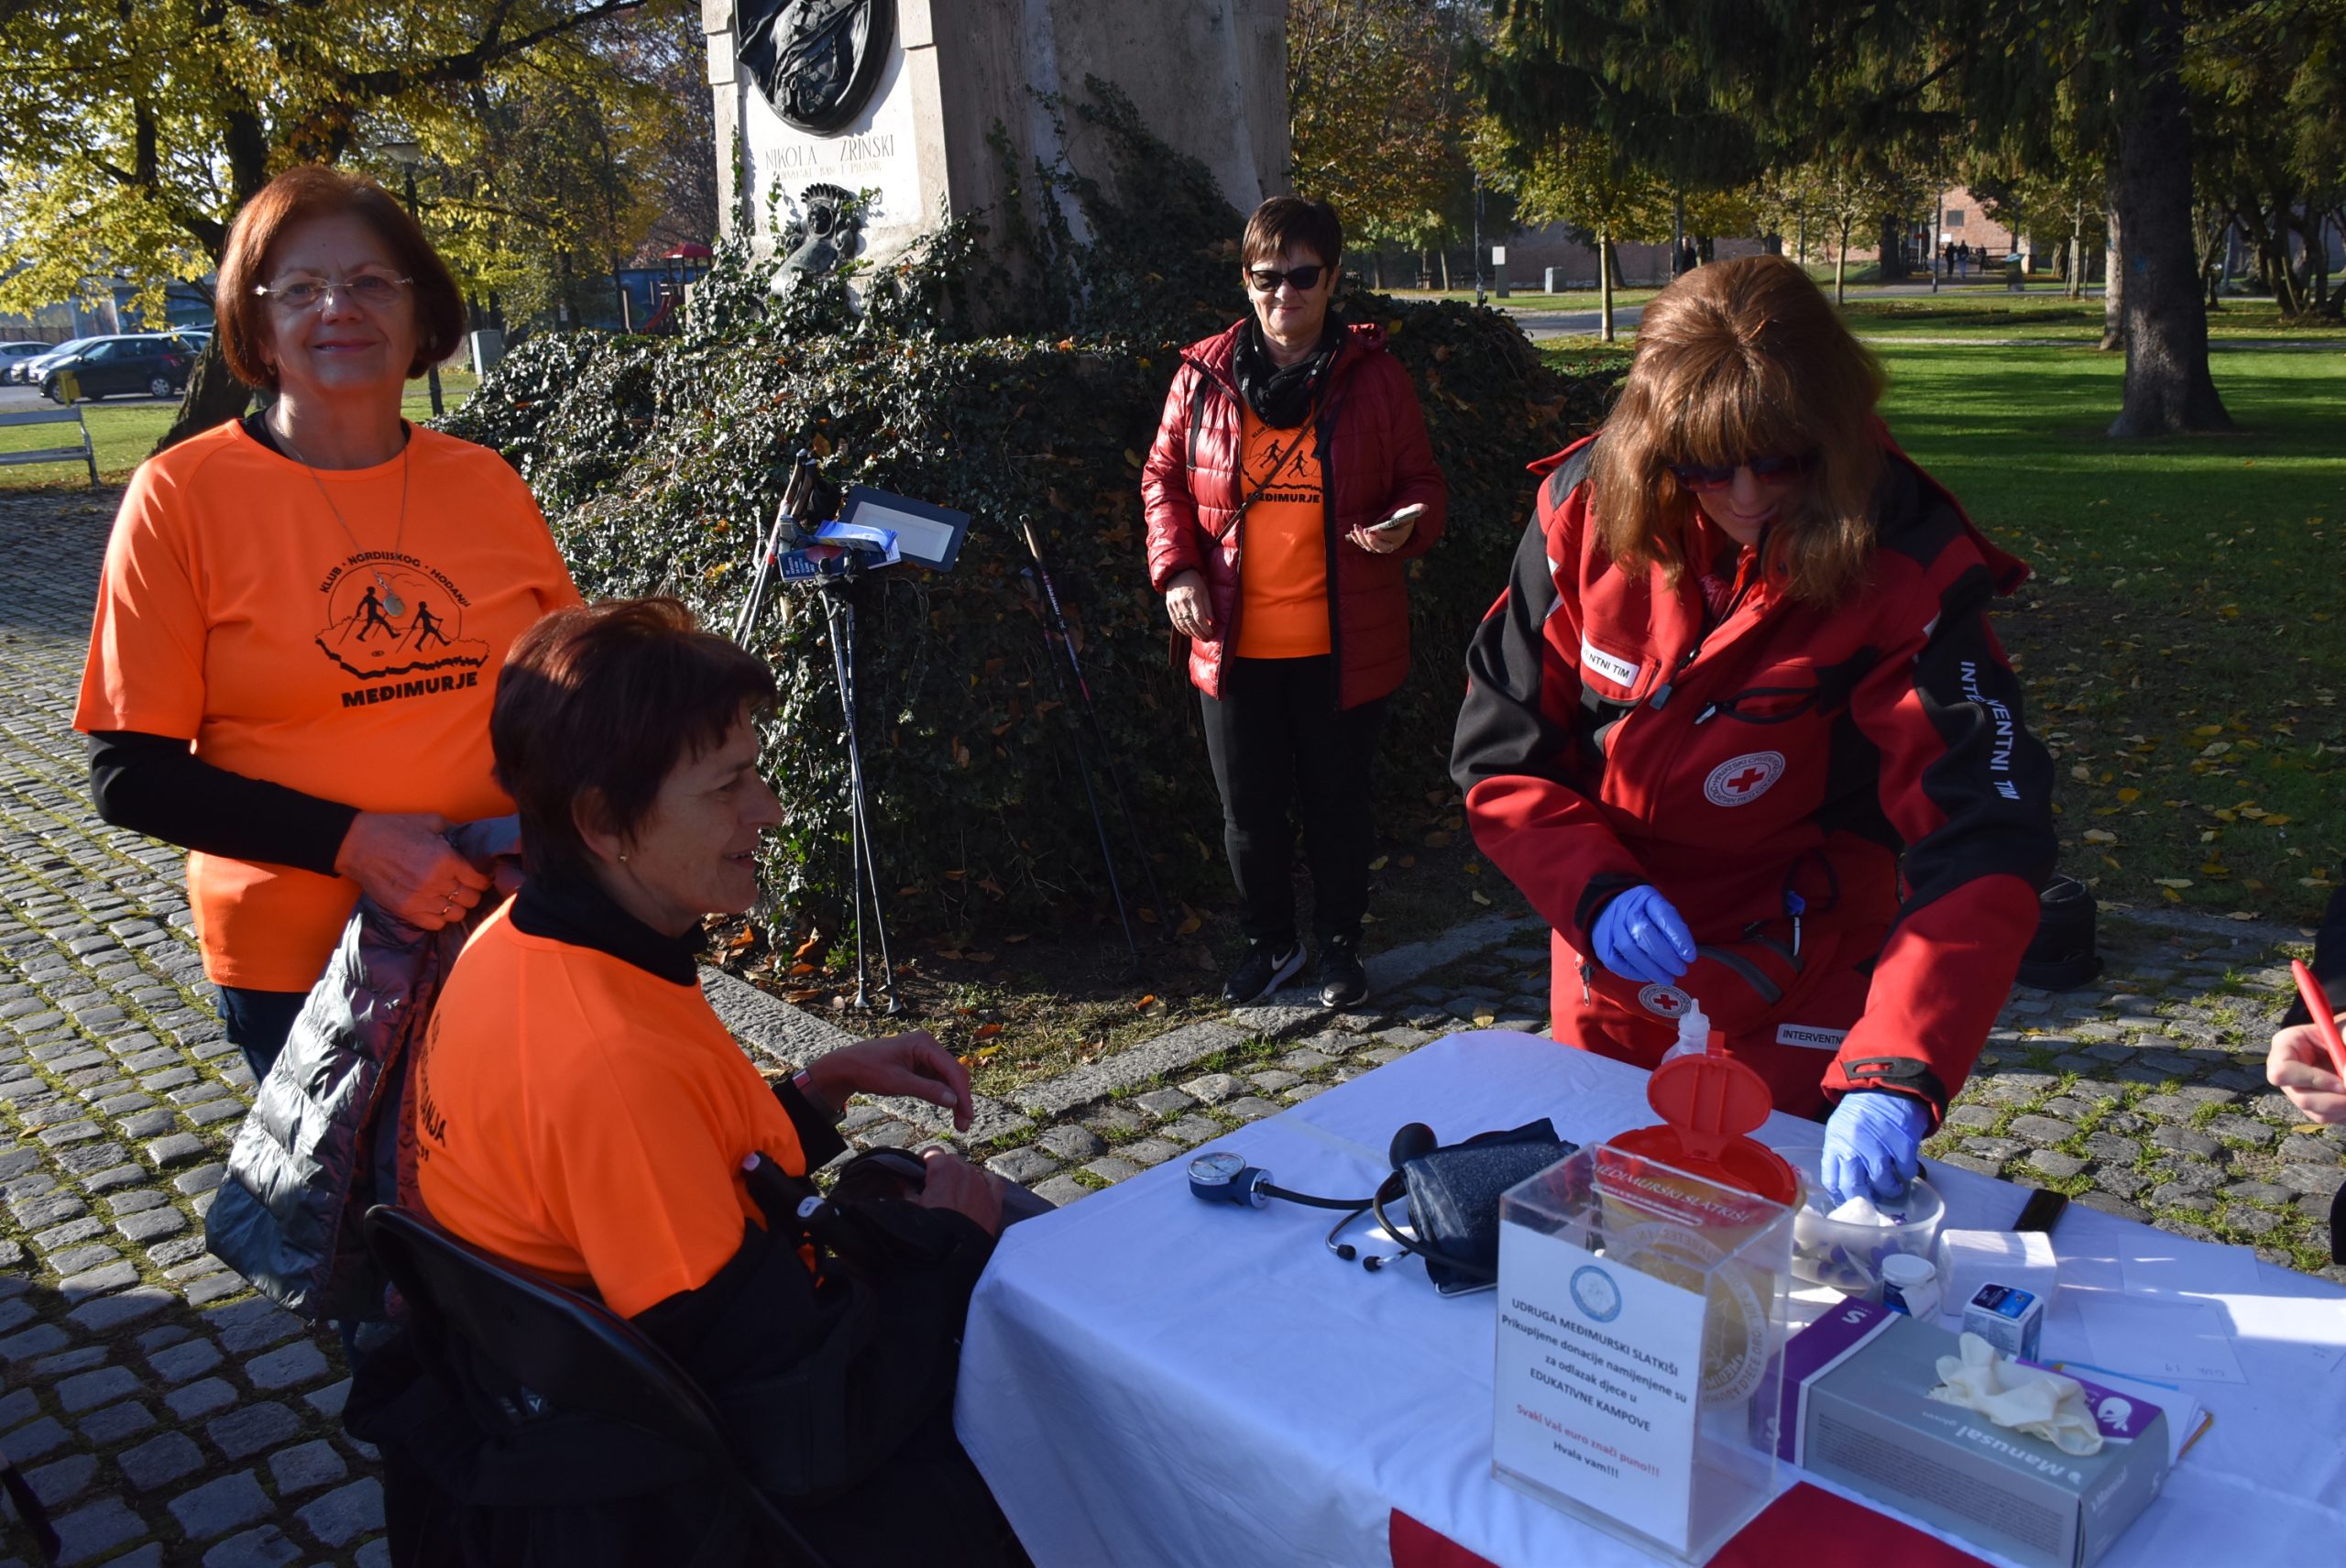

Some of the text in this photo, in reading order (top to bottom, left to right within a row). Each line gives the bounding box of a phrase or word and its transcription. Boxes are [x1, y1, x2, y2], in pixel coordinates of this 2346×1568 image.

[765, 134, 894, 170] NIKOLA ZRINSKI
[319, 565, 343, 594] KLUB
[347, 551, 421, 568] NORDIJSKOG
[341, 672, 478, 707] MEĐIMURJE
[1613, 663, 1630, 680] TIM
[1959, 661, 2022, 801] INTEVENTNI TIM
[1512, 1298, 1679, 1375] UDRUGA MEĐIMURSKI SLATKIŠI
[1840, 1310, 1868, 1324] S
[1501, 1314, 1687, 1403] Prikupljene donacije namijenjene su
[1545, 1354, 1638, 1403] za odlazak djece u
[1529, 1367, 1650, 1432] EDUKATIVNE KAMPOVE
[1517, 1404, 1542, 1424] Svaki
[1564, 1428, 1589, 1445] euro
[1591, 1439, 1617, 1457] znači
[1619, 1452, 1661, 1478] puno!!!
[1553, 1440, 1619, 1479] Hvala vam!!!
[1955, 1425, 2066, 1477] Manusal
